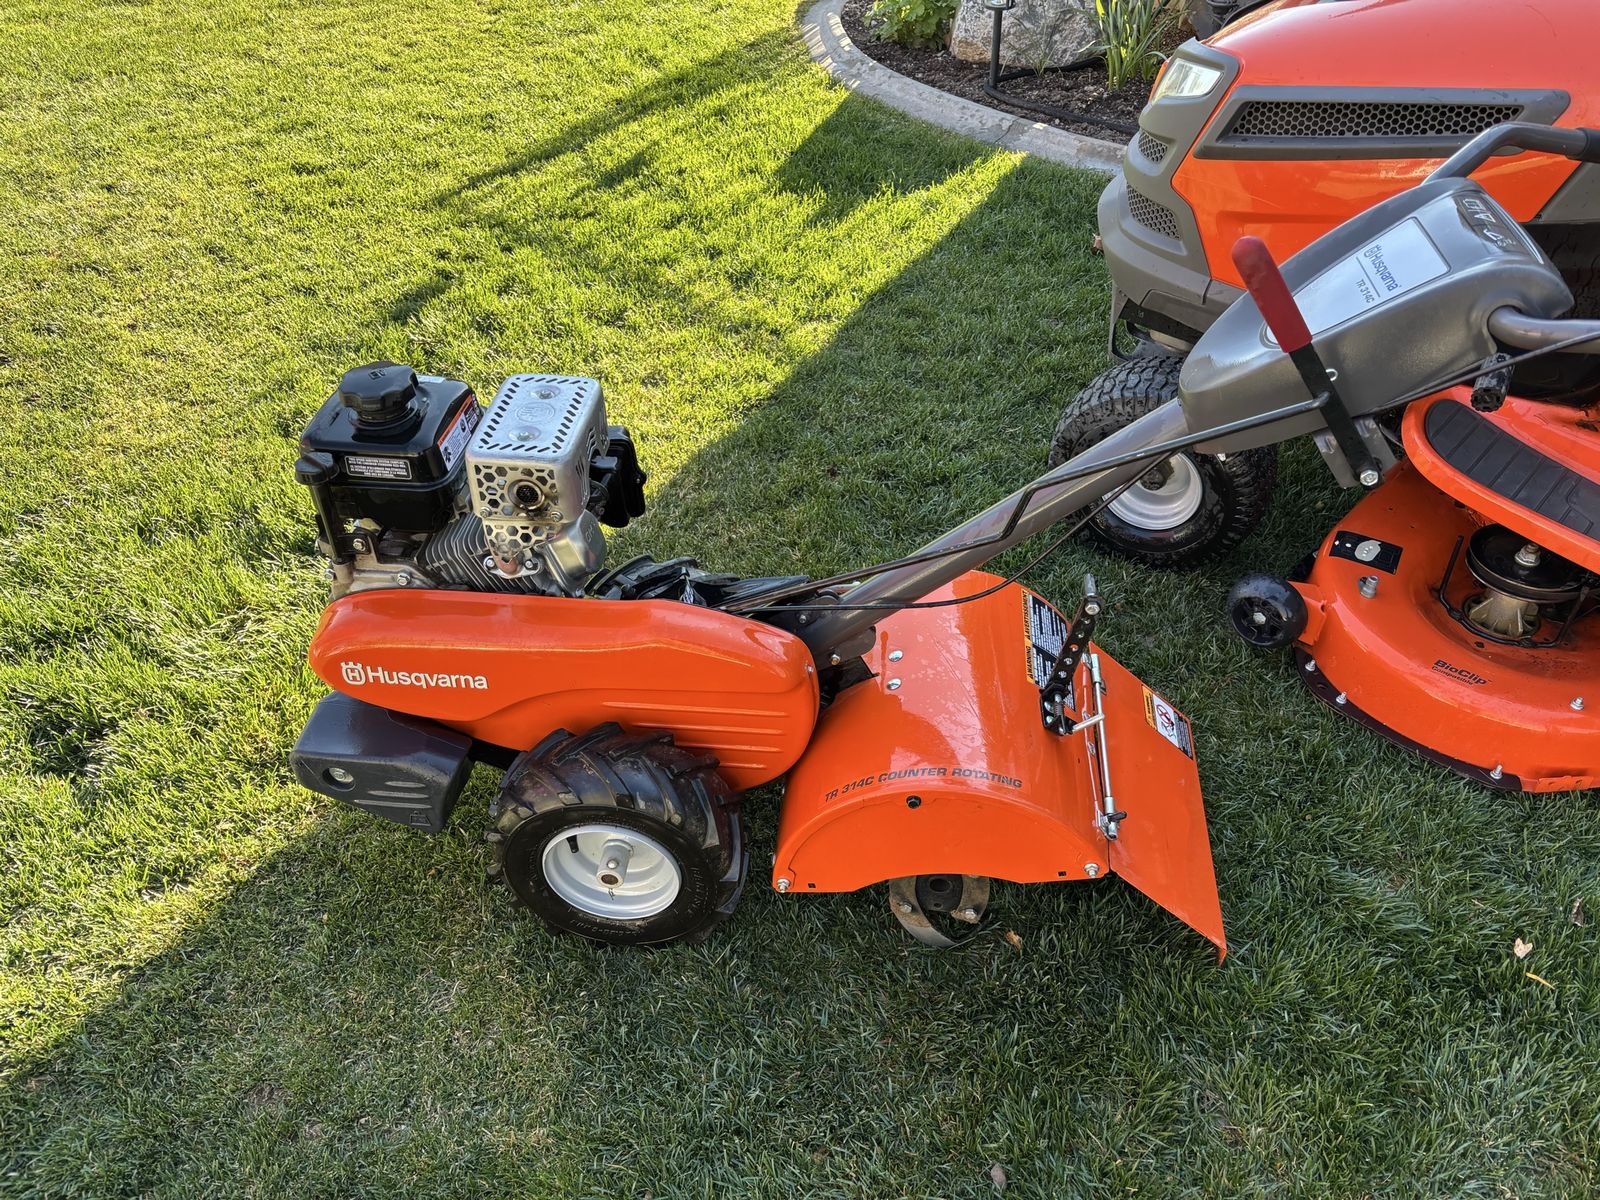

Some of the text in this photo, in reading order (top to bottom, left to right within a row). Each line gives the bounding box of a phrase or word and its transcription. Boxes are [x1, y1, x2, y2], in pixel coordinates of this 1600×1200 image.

[1369, 253, 1399, 292] Husqvarna
[1355, 279, 1375, 303] TR 314C
[366, 665, 489, 689] Husqvarna
[1431, 665, 1474, 686] Compatible
[1434, 659, 1488, 685] BioClip
[824, 767, 1023, 802] TR 314C COUNTER ROTATING
